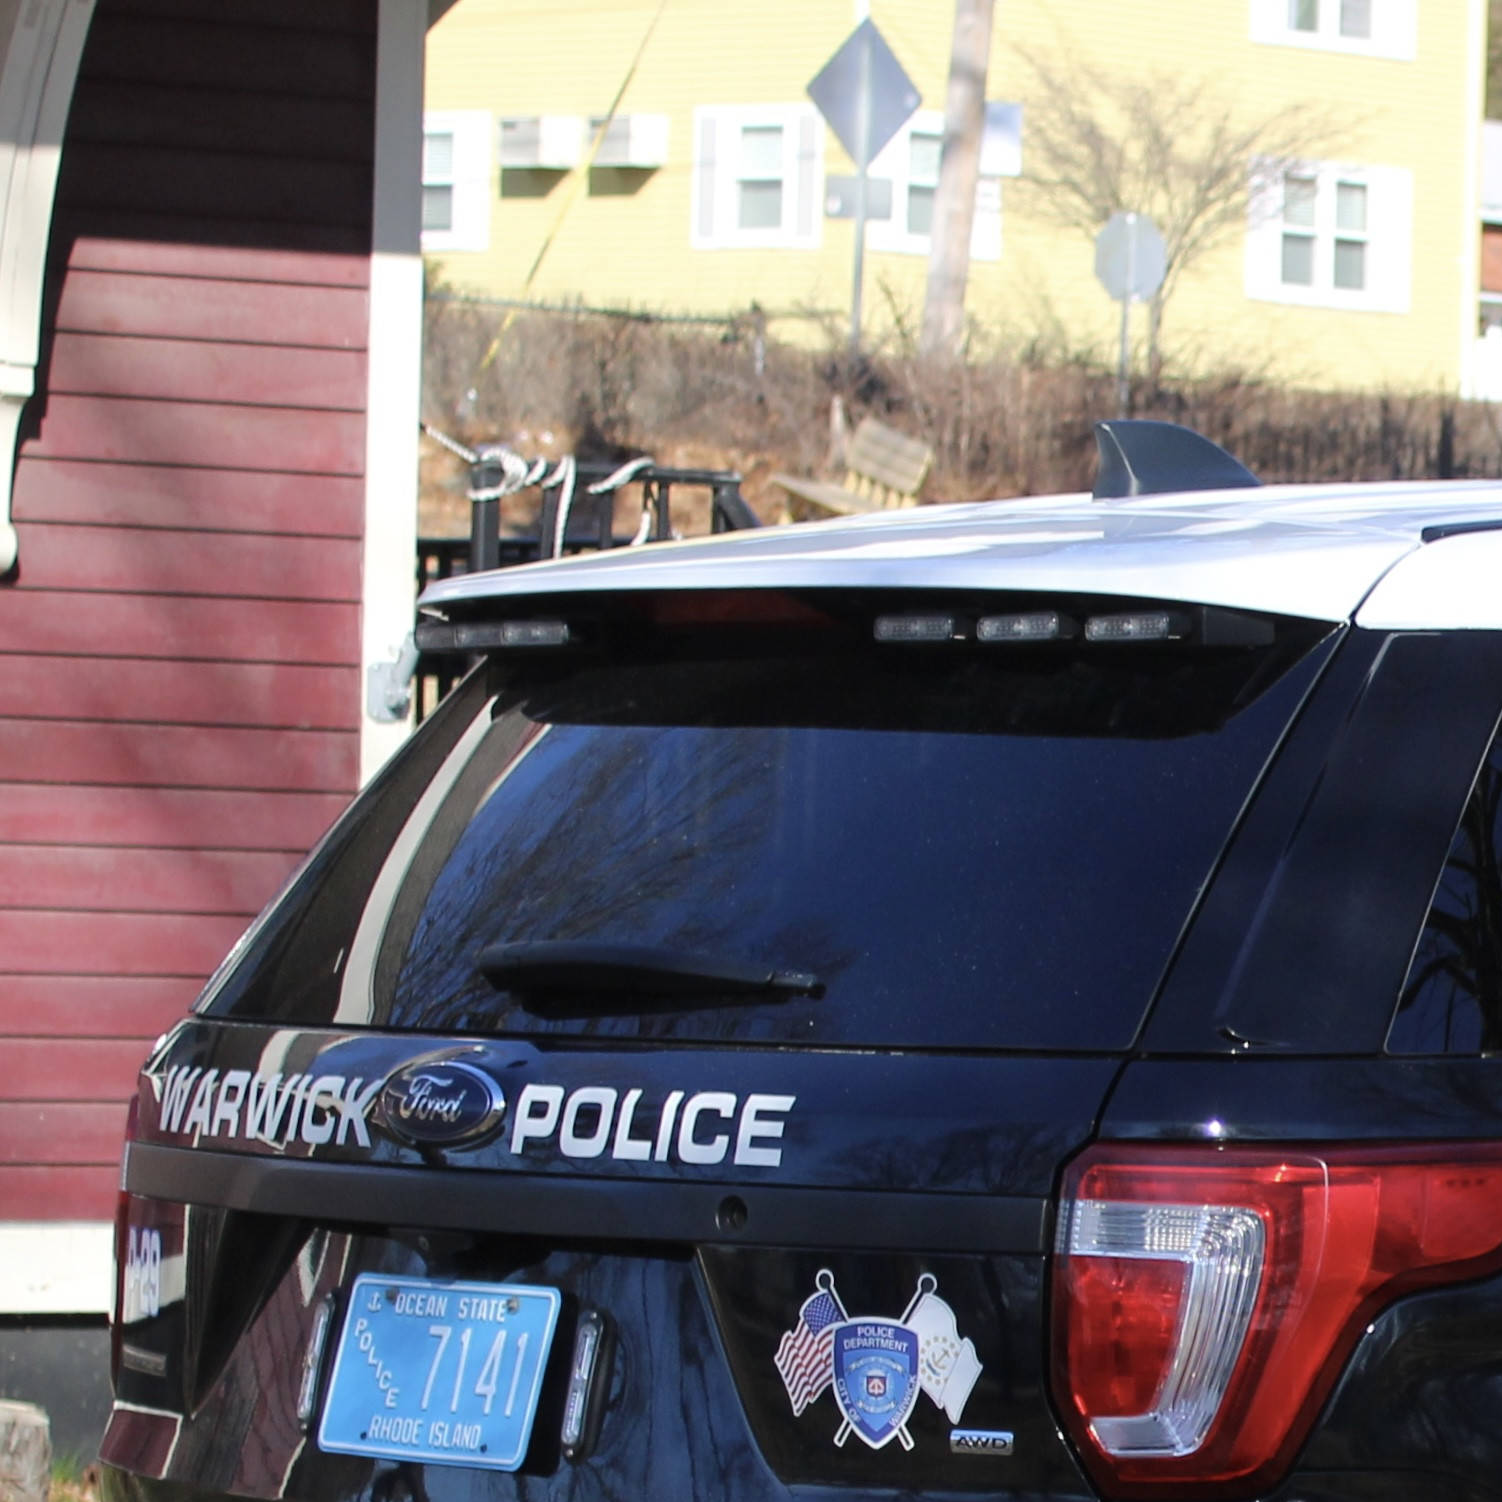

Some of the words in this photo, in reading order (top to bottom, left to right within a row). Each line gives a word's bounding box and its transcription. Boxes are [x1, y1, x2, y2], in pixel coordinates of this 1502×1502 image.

[159, 1065, 389, 1148] WARWICK
[401, 1074, 467, 1121] Ford
[510, 1083, 796, 1167] POLICE
[394, 1293, 447, 1318] OCEAN
[458, 1298, 508, 1322] STATE
[843, 1338, 909, 1353] DEPARTMENT
[857, 1326, 895, 1338] POLICE
[354, 1316, 399, 1408] POLICE
[420, 1325, 528, 1417] 7141
[837, 1378, 851, 1405] CITY
[849, 1408, 861, 1423] OF
[889, 1374, 917, 1427] WARWICK
[368, 1416, 423, 1445] RHODE
[428, 1421, 482, 1449] ISLAND
[955, 1436, 1008, 1450] AWD
